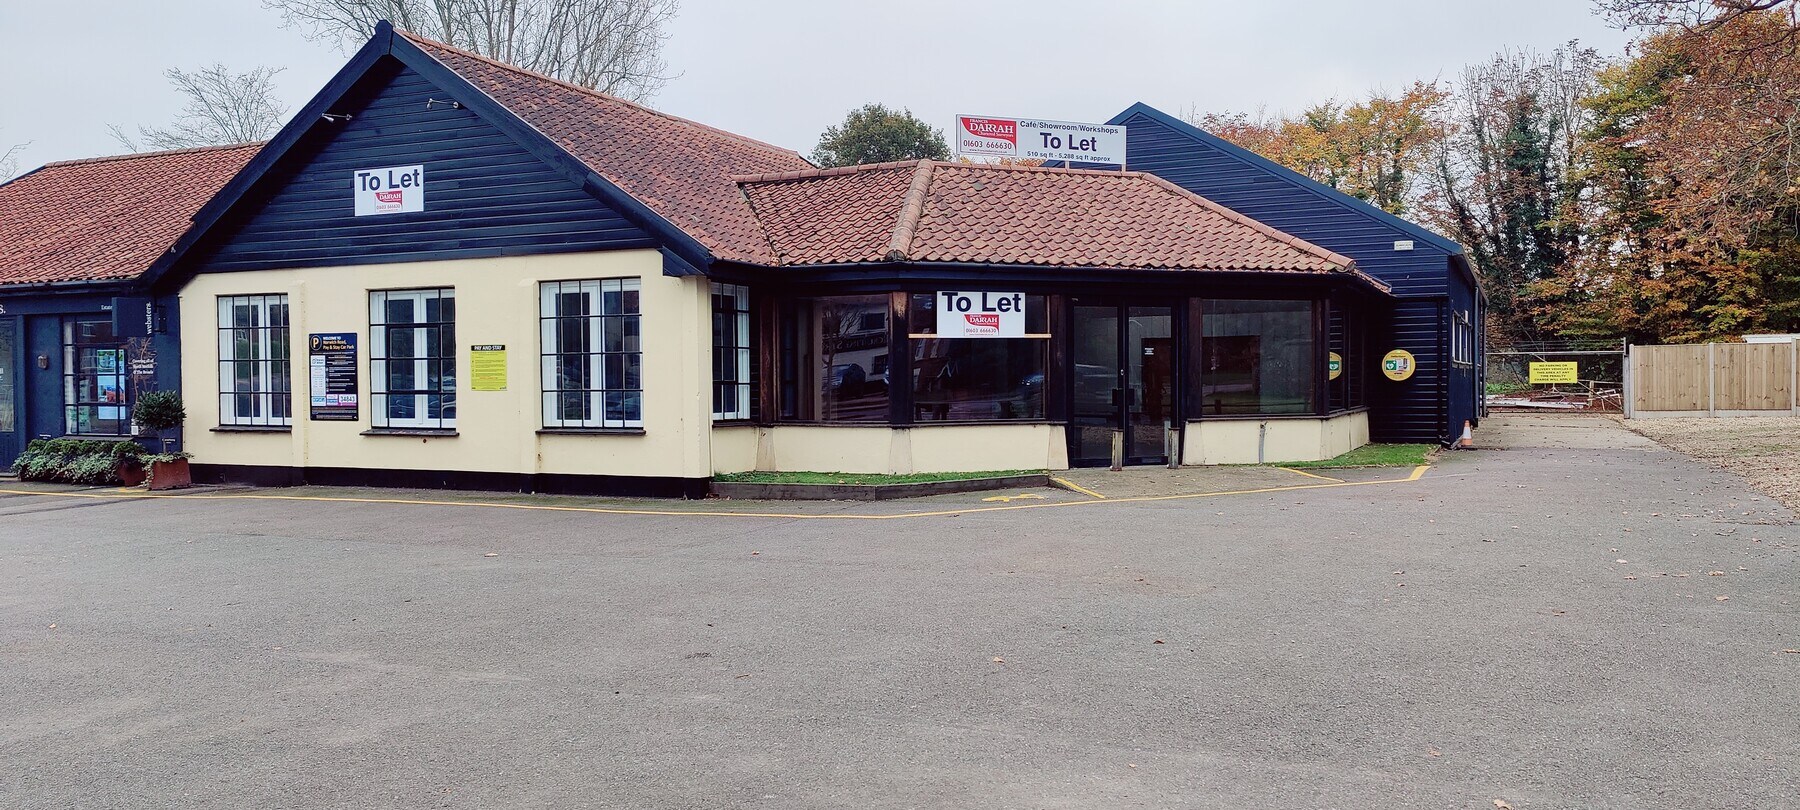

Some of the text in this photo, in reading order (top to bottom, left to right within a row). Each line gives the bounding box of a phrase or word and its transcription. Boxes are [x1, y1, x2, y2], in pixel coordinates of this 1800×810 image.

[969, 123, 1014, 134] DARRAH
[986, 142, 1012, 150] 666630
[1040, 132, 1097, 151] To Let
[358, 169, 420, 191] To Let
[942, 292, 1022, 312] To Let
[313, 338, 319, 348] P
